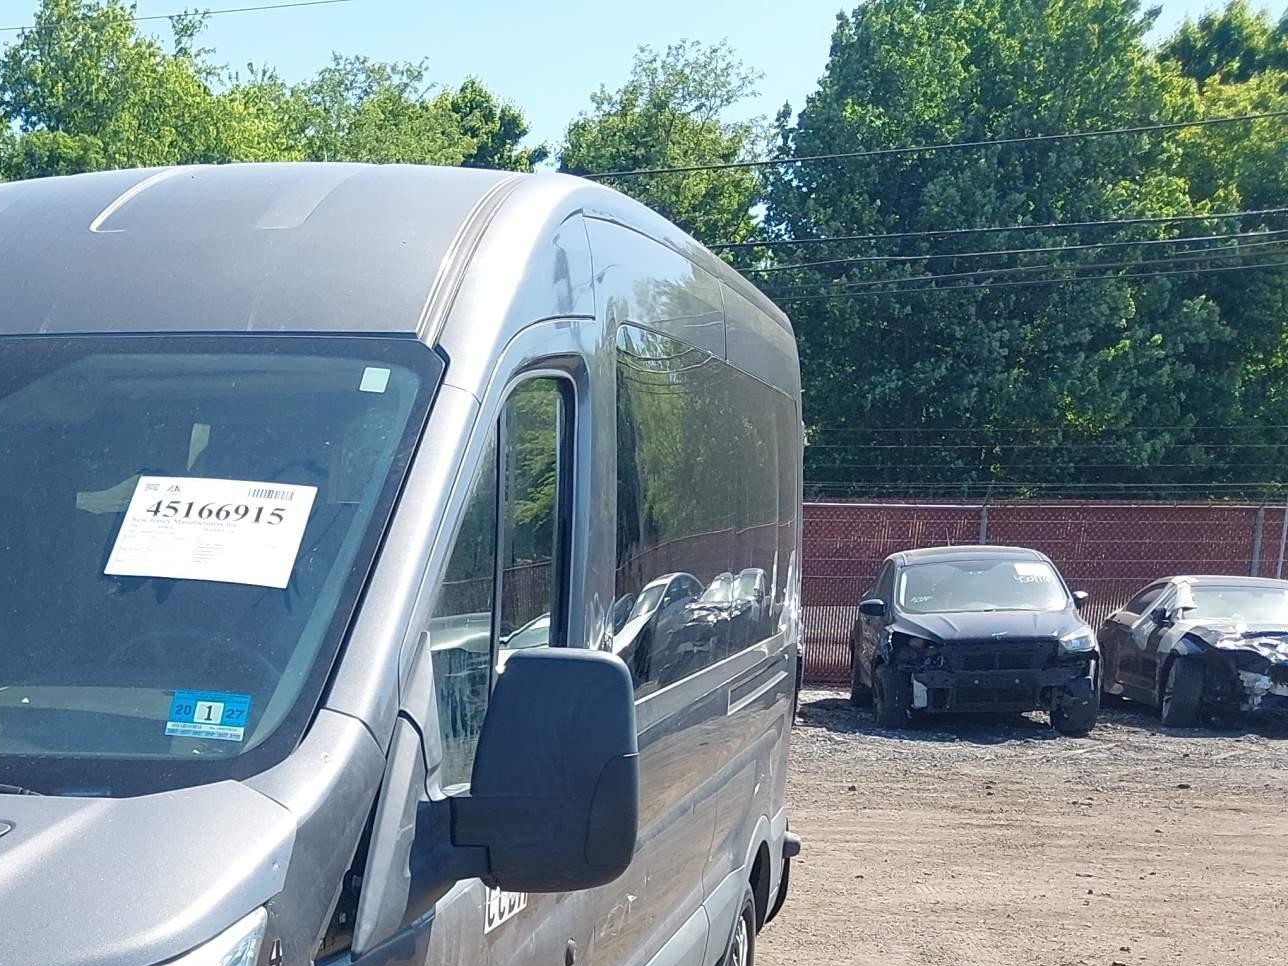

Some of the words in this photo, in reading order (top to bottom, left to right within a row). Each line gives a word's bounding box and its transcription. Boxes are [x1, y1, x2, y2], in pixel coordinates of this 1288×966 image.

[146, 499, 287, 526] 45166915
[175, 704, 192, 716] 20
[203, 704, 213, 721] 1
[225, 708, 245, 720] 27
